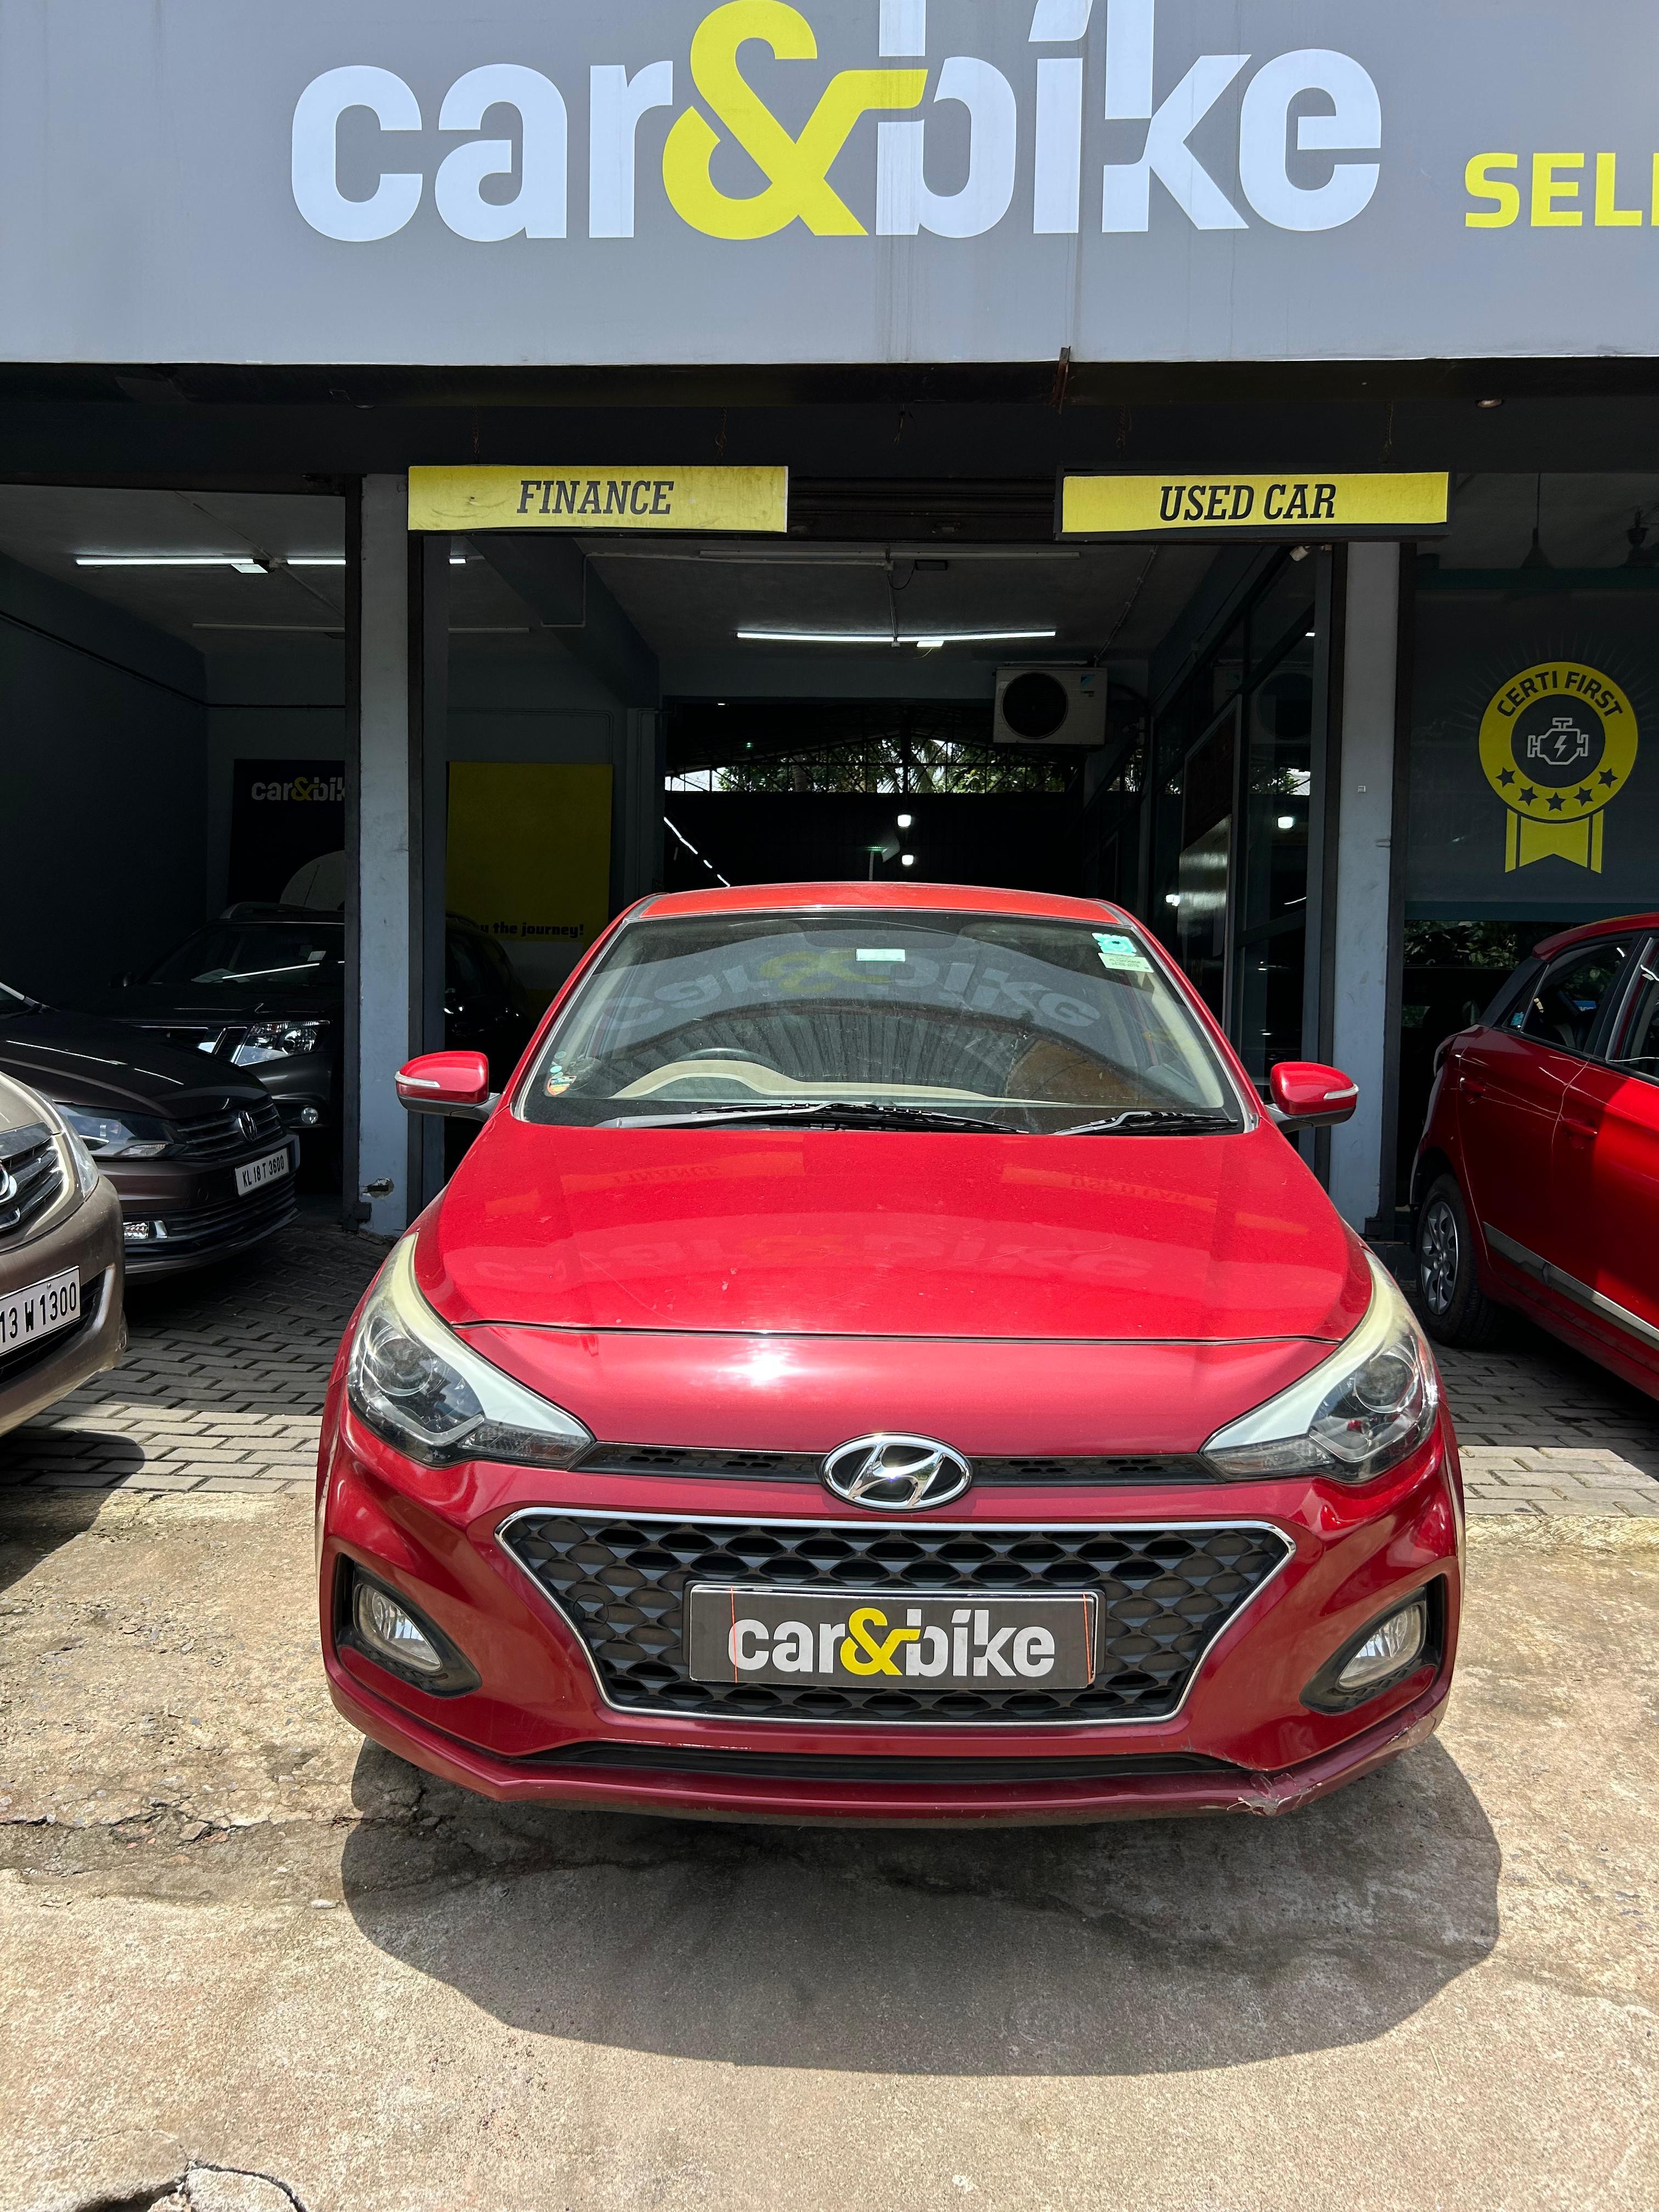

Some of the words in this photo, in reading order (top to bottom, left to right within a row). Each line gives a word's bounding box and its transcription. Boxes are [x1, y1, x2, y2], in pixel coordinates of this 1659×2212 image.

[292, 0, 1381, 242] car&bike
[1465, 153, 1659, 228] SEL
[516, 480, 675, 515] FINANCE
[1159, 485, 1254, 521] USED
[1263, 483, 1337, 519] CAR
[1497, 670, 1558, 717] CERTI
[1564, 670, 1623, 718] FIRST
[493, 922, 518, 934] the
[521, 922, 584, 939] journey!
[242, 1170, 252, 1188] KL
[253, 1165, 261, 1183] 18
[262, 1163, 267, 1178] T
[268, 1155, 285, 1176] 3600
[0, 1307, 18, 1344] 13
[24, 1299, 34, 1333] W
[40, 1281, 77, 1325] 1300
[728, 1607, 1055, 1677] car&bike
